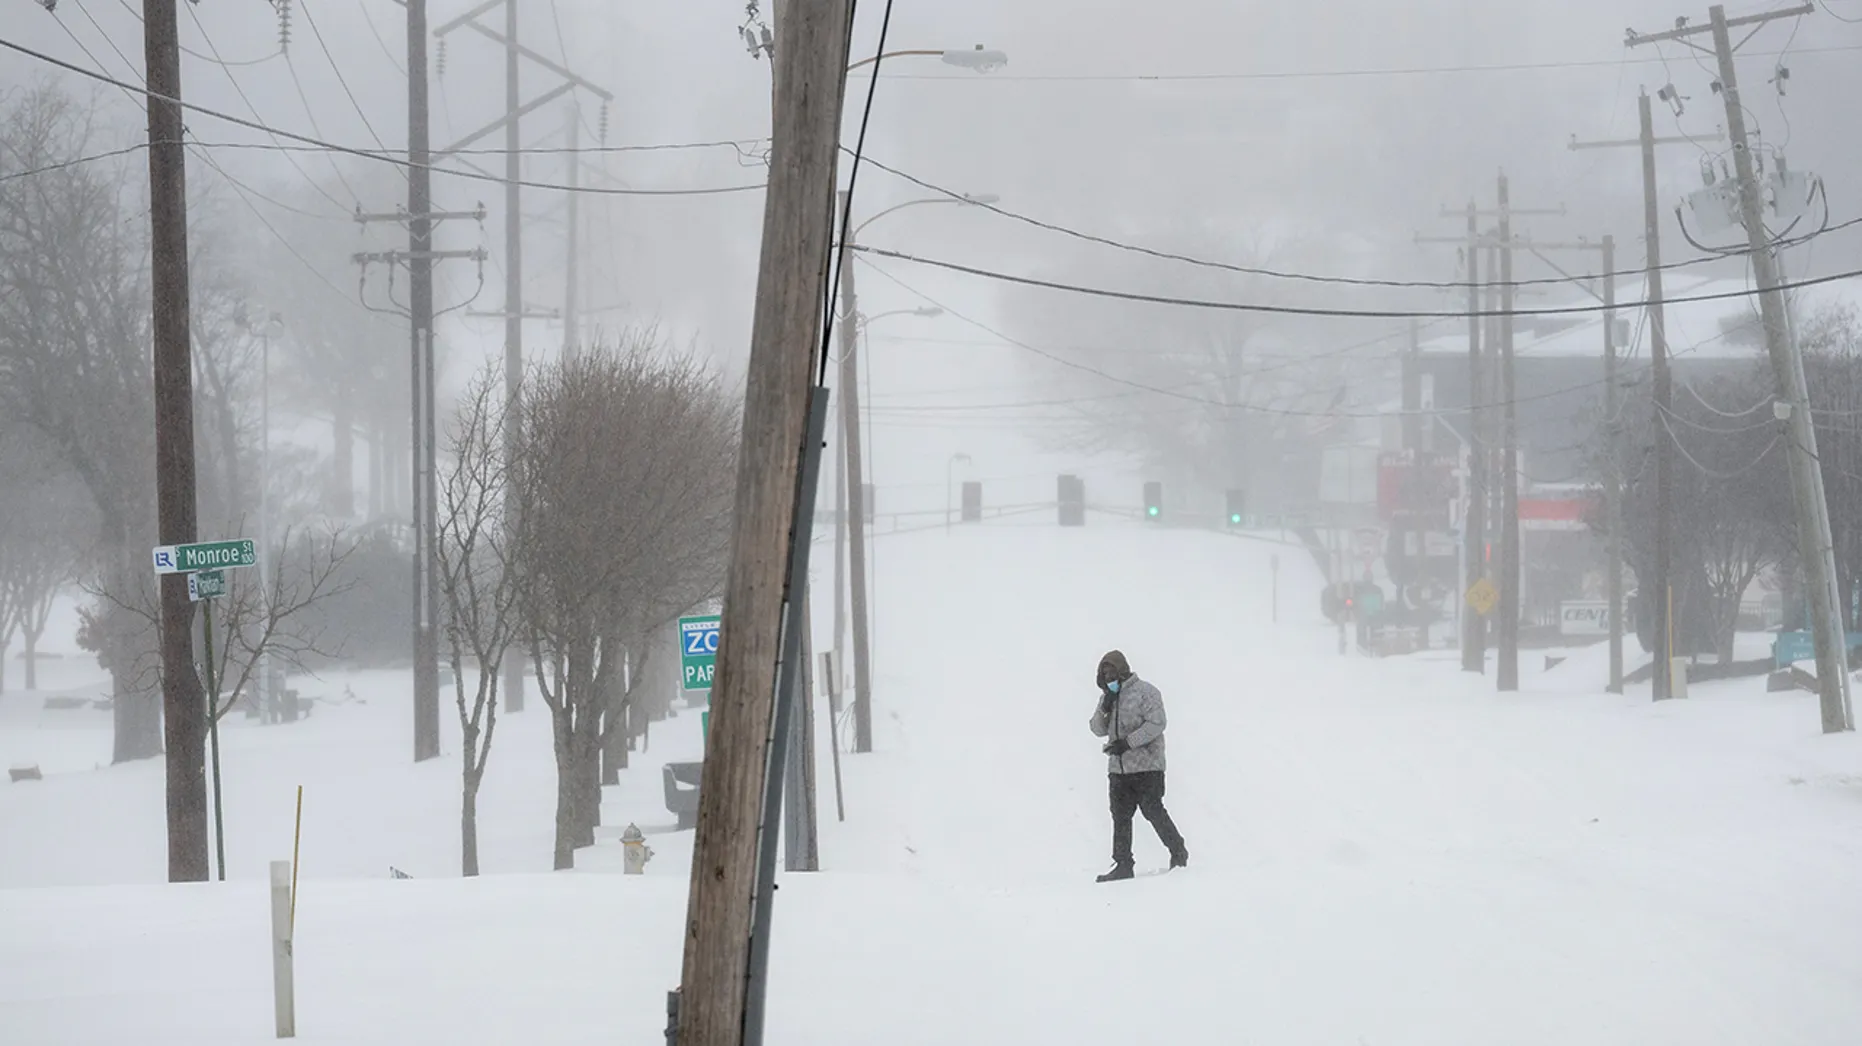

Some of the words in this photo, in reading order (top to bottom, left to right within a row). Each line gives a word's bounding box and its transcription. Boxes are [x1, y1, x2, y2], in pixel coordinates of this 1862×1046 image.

[186, 548, 239, 566] Monroe
[243, 541, 252, 552] St
[685, 665, 715, 682] PAR
